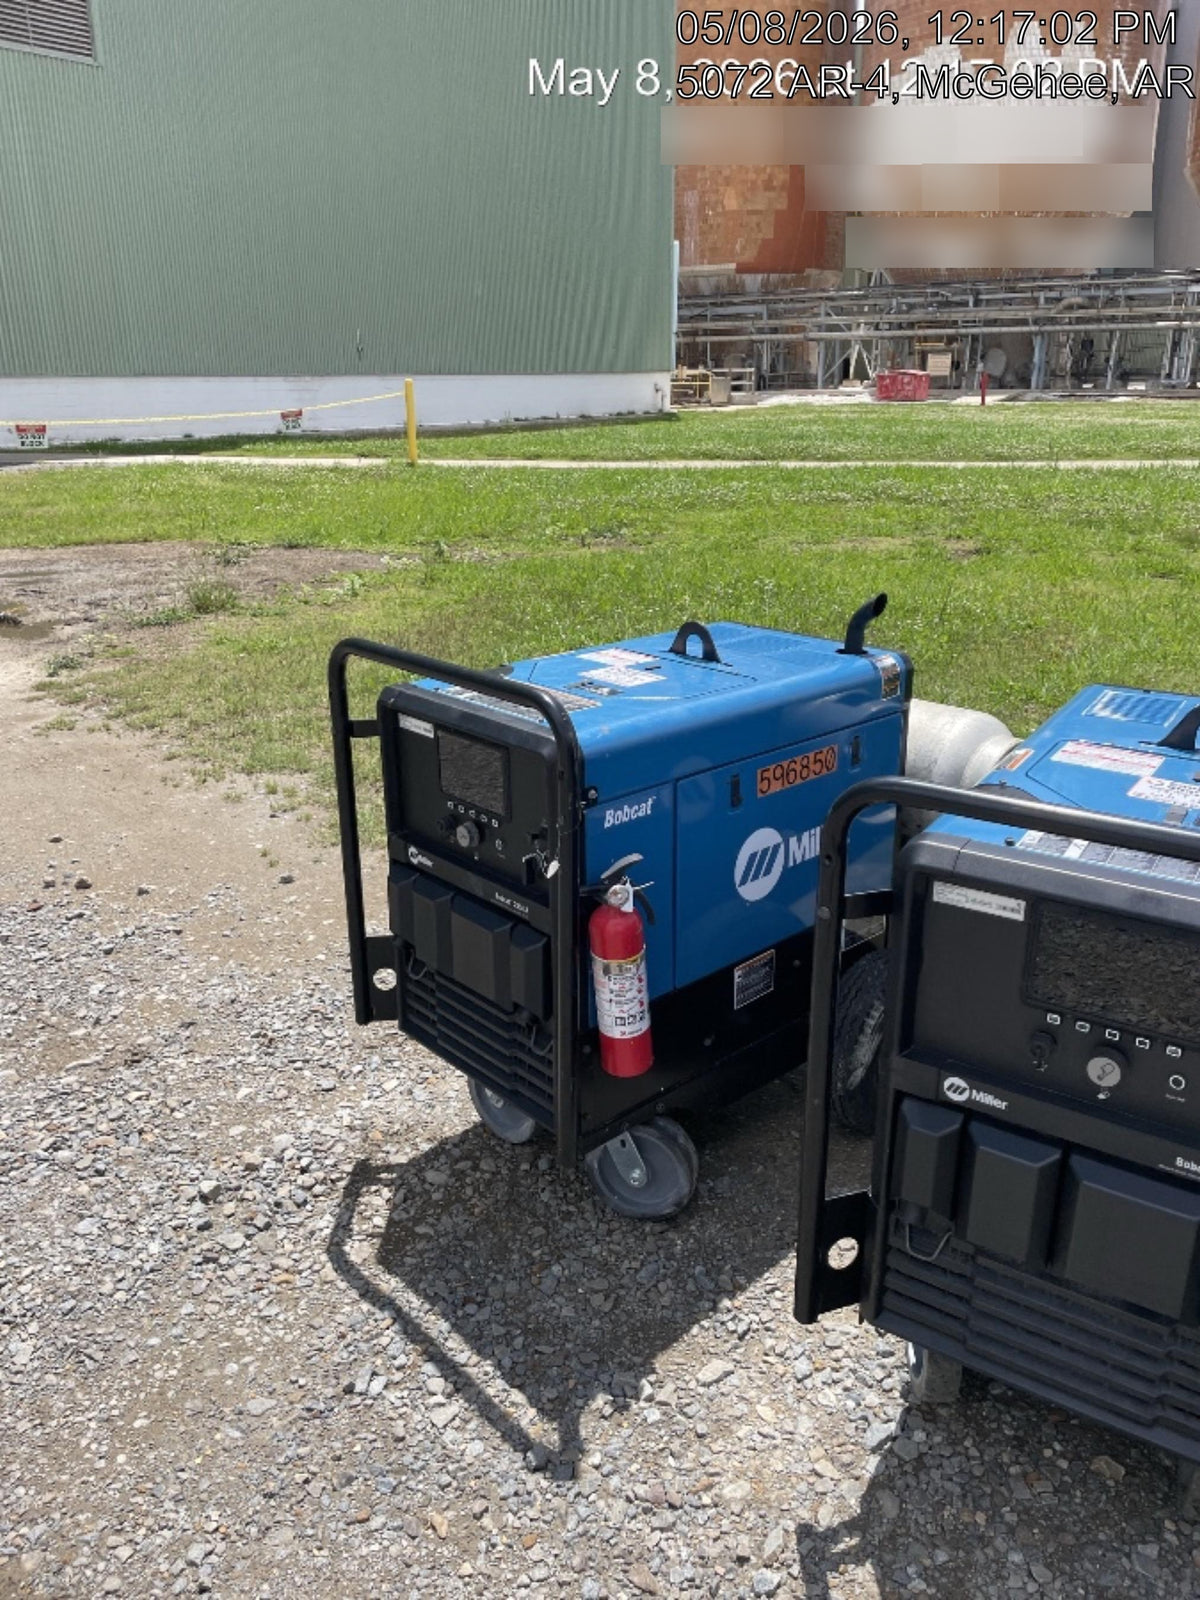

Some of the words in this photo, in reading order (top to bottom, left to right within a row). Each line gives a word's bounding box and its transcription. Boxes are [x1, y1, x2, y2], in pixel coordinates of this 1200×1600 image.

[759, 746, 836, 794] 596850
[604, 797, 655, 828] Bobcat
[788, 825, 824, 868] Mil
[971, 1088, 1009, 1110] Miller
